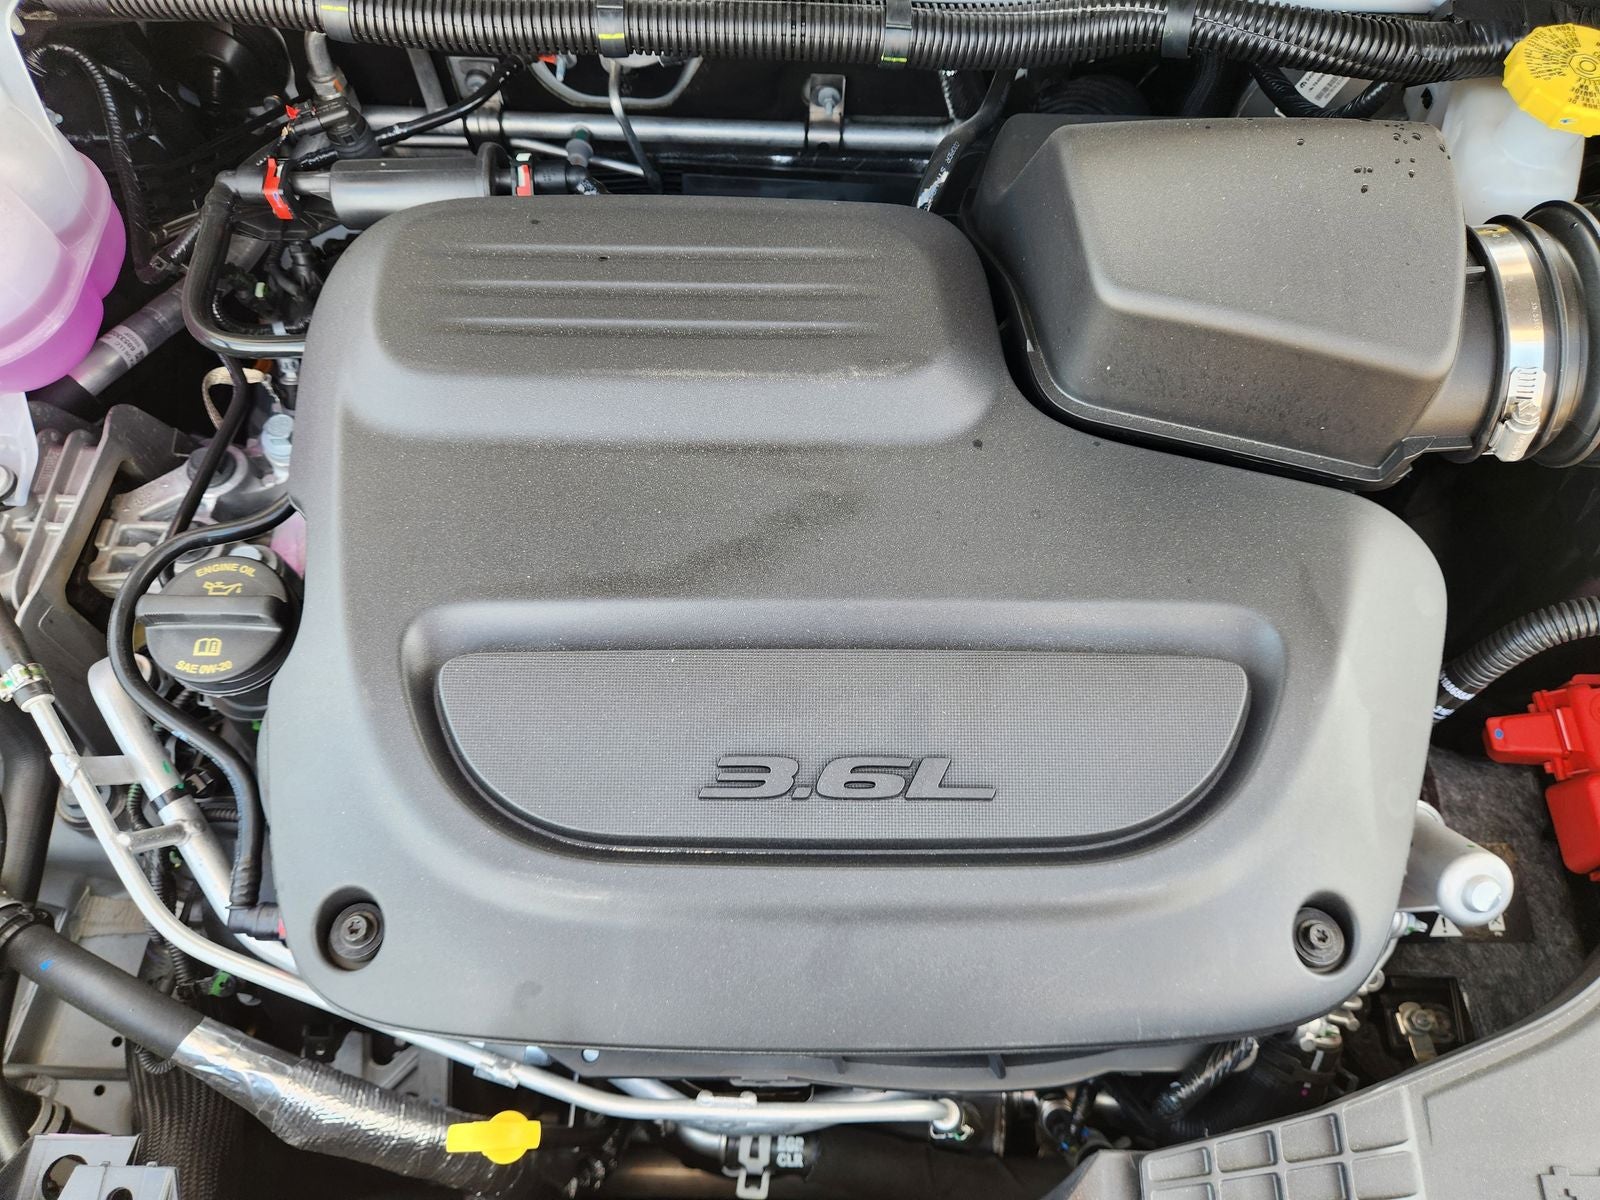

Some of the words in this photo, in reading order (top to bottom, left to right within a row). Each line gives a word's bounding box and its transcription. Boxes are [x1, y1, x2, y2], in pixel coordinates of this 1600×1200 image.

[195, 563, 239, 577] ENGINE
[239, 565, 257, 577] OIL
[175, 660, 198, 674] SAE
[198, 660, 233, 675] 0W-20
[698, 754, 997, 801] 3.6L
